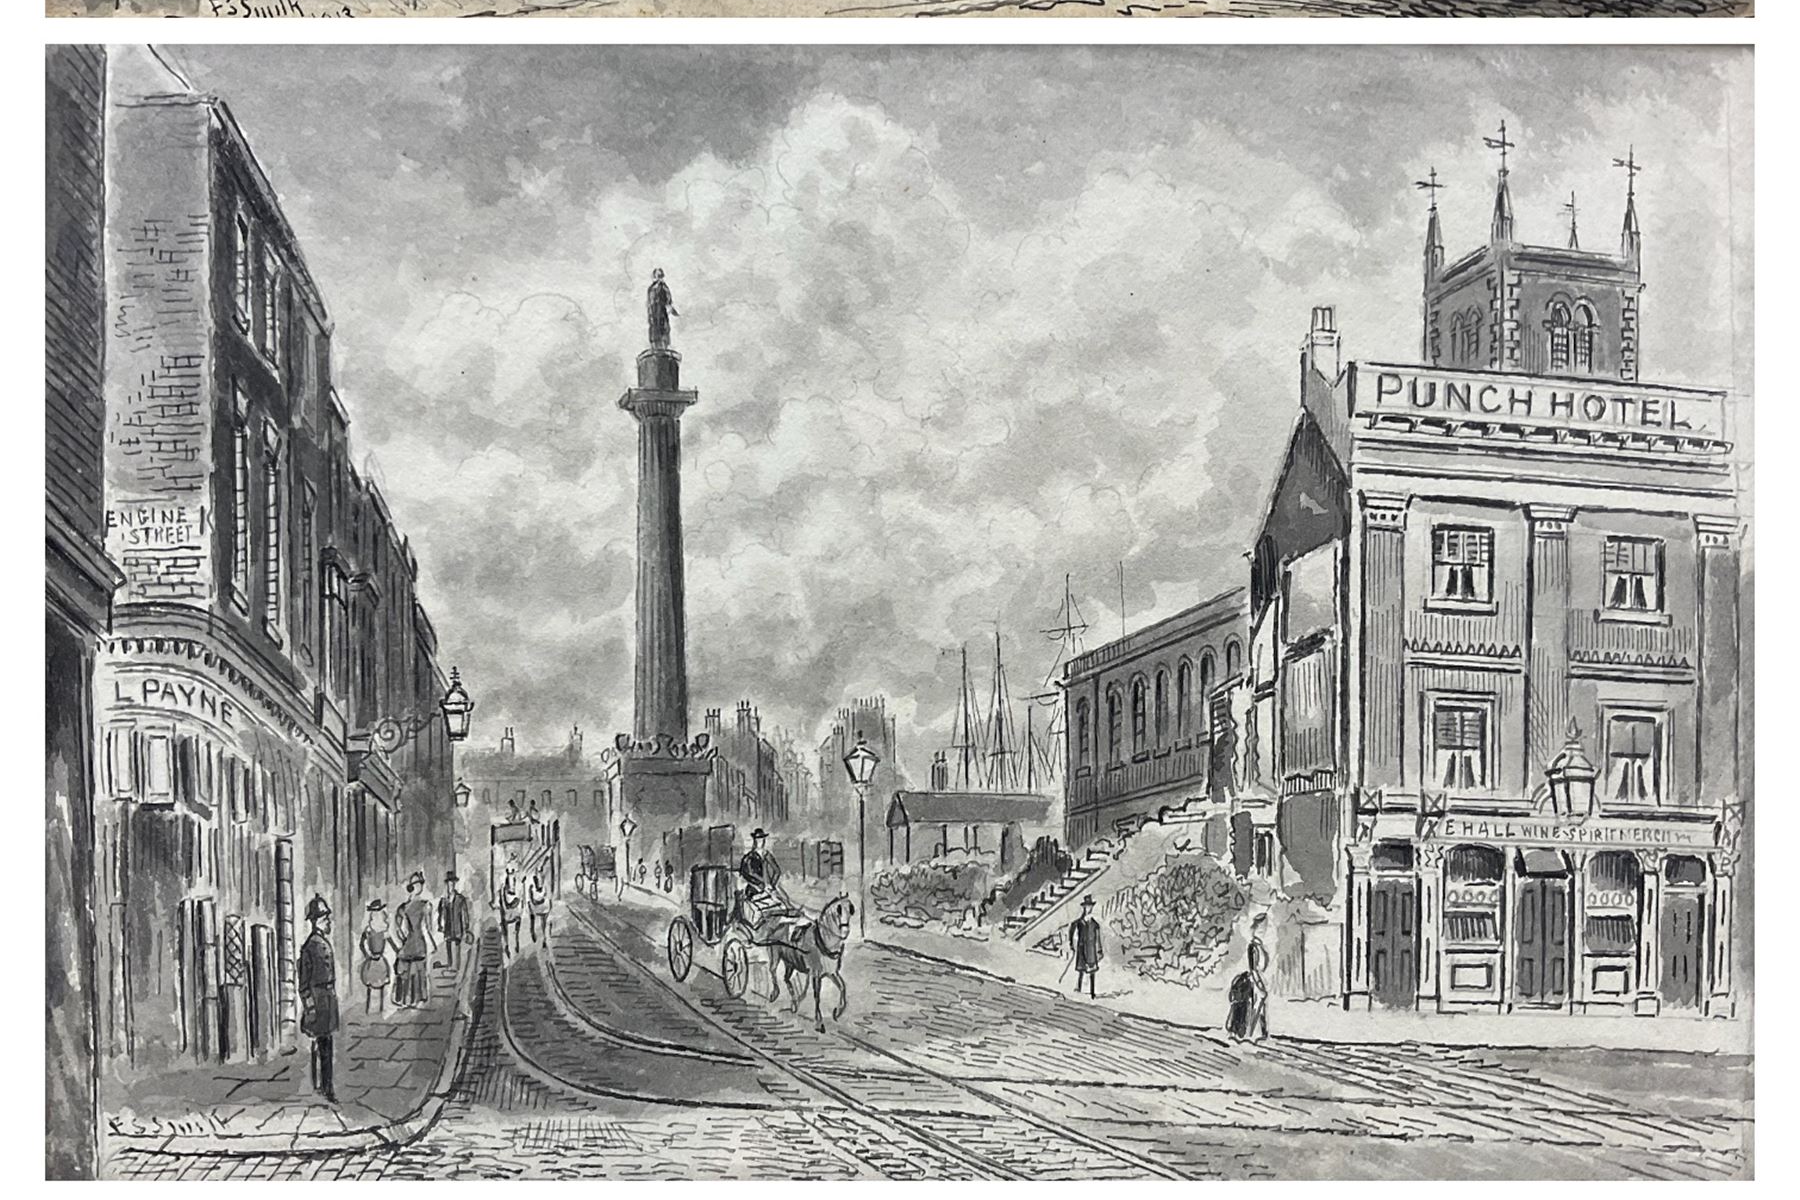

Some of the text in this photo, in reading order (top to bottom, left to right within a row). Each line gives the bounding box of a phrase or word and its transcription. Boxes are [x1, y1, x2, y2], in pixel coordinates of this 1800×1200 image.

[1376, 373, 1533, 417] PUNCH
[105, 506, 187, 528] ENGINE
[128, 525, 193, 546] STREET
[115, 678, 233, 729] L PAYNE
[1445, 819, 1455, 835] E
[1463, 821, 1515, 838] HALL
